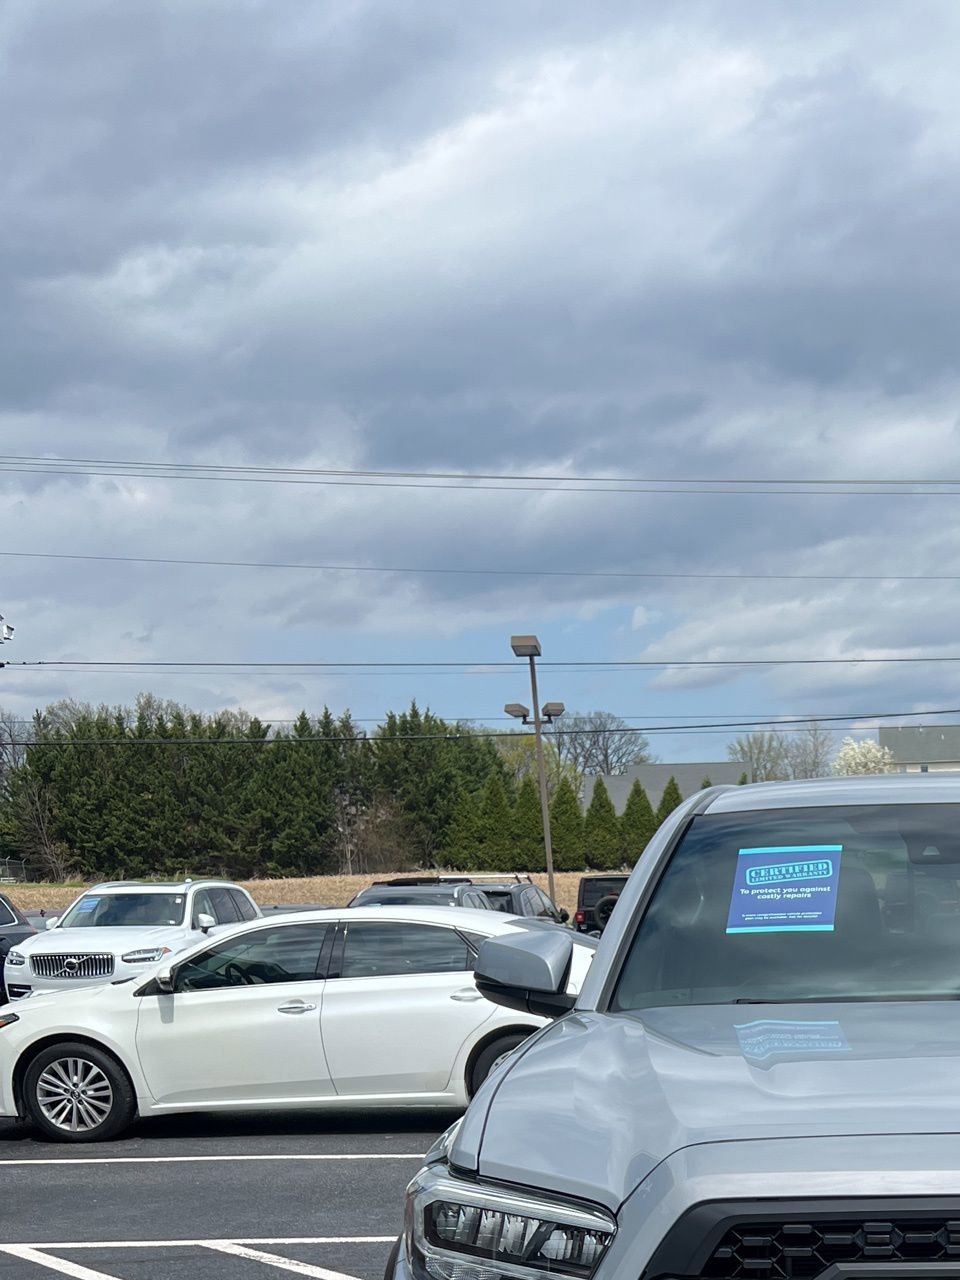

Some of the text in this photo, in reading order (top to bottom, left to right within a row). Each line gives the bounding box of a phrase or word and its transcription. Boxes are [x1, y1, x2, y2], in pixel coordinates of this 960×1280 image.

[750, 862, 828, 878] CERTIFIED
[751, 871, 828, 883] LIMITED WARRANTY
[751, 887, 781, 895] protect
[783, 892, 812, 900] repairs
